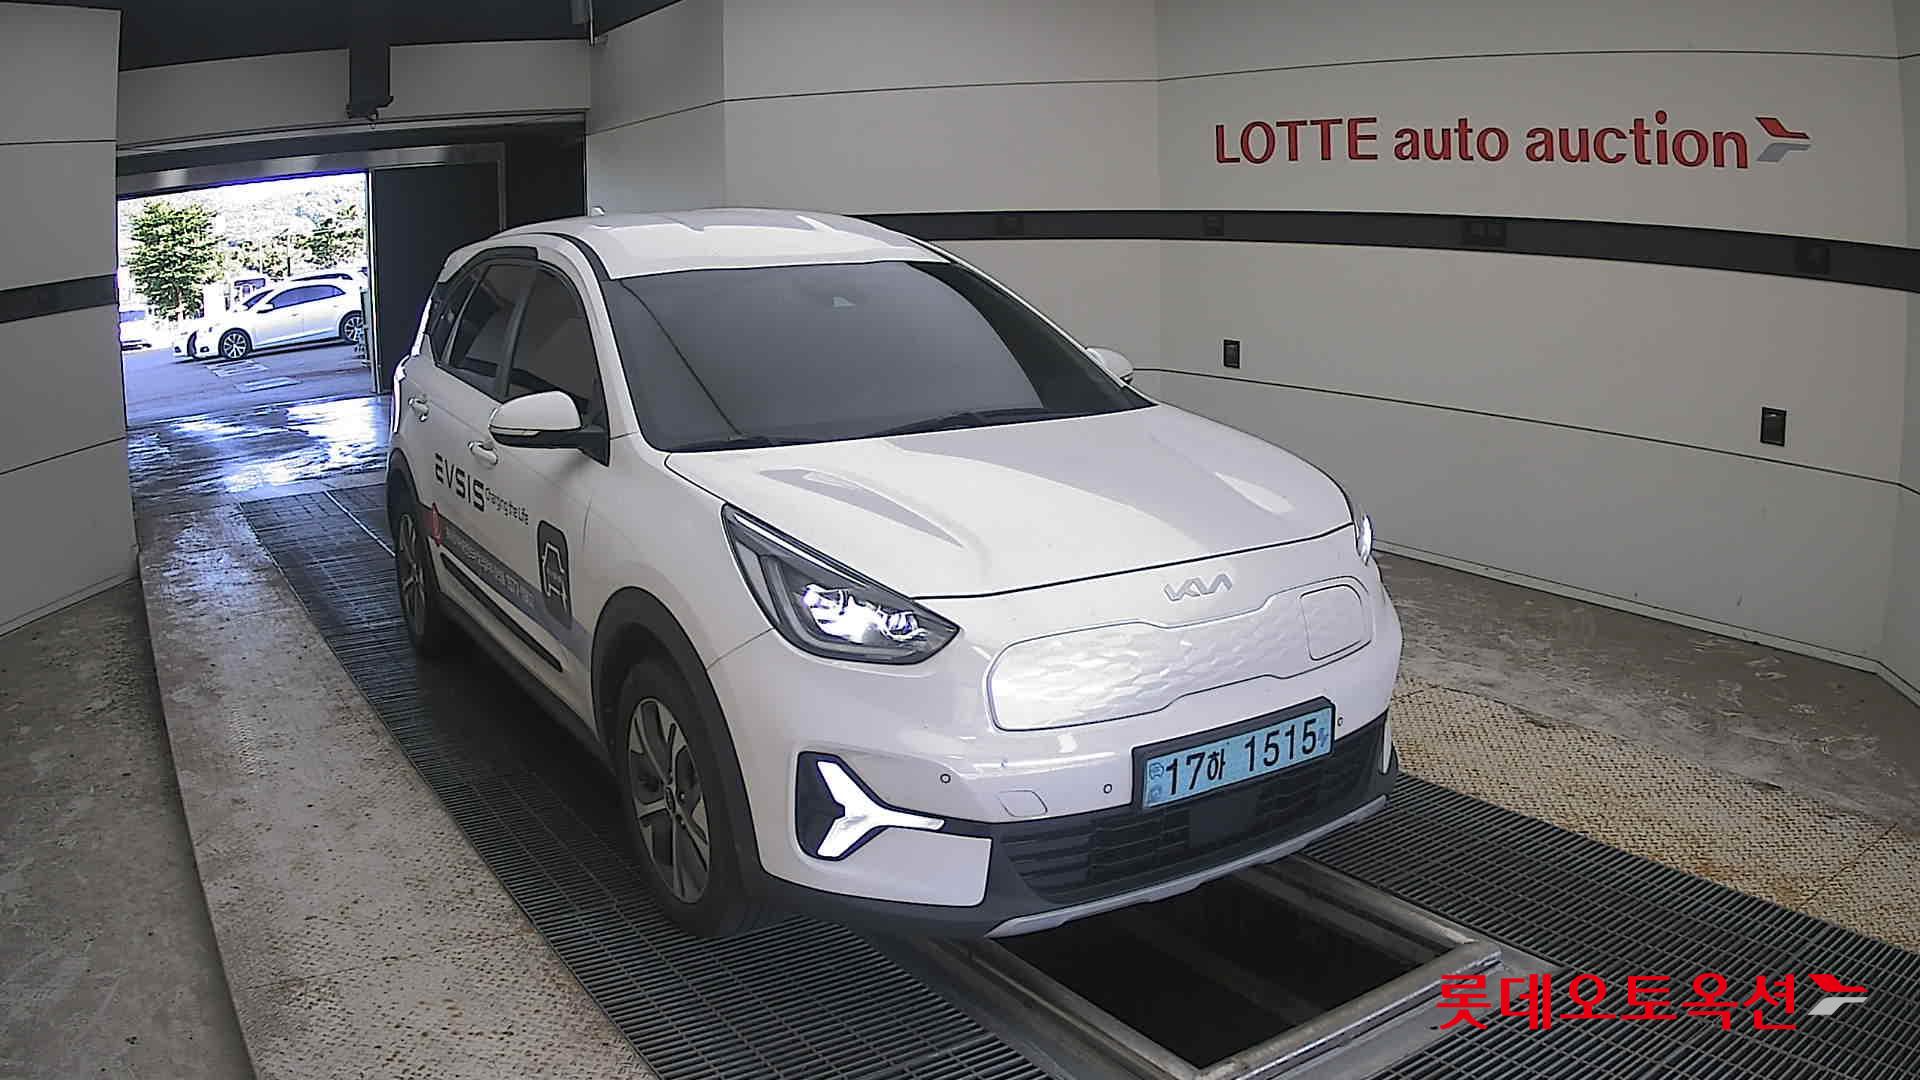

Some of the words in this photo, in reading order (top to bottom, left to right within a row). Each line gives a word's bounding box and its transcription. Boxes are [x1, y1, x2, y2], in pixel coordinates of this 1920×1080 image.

[1215, 117, 1378, 164] LOTTE
[1394, 117, 1509, 162] auto
[1525, 110, 1748, 169] auction
[434, 452, 485, 512] EVSIS
[1166, 748, 1226, 796] 17하
[1245, 718, 1317, 772] 1515
